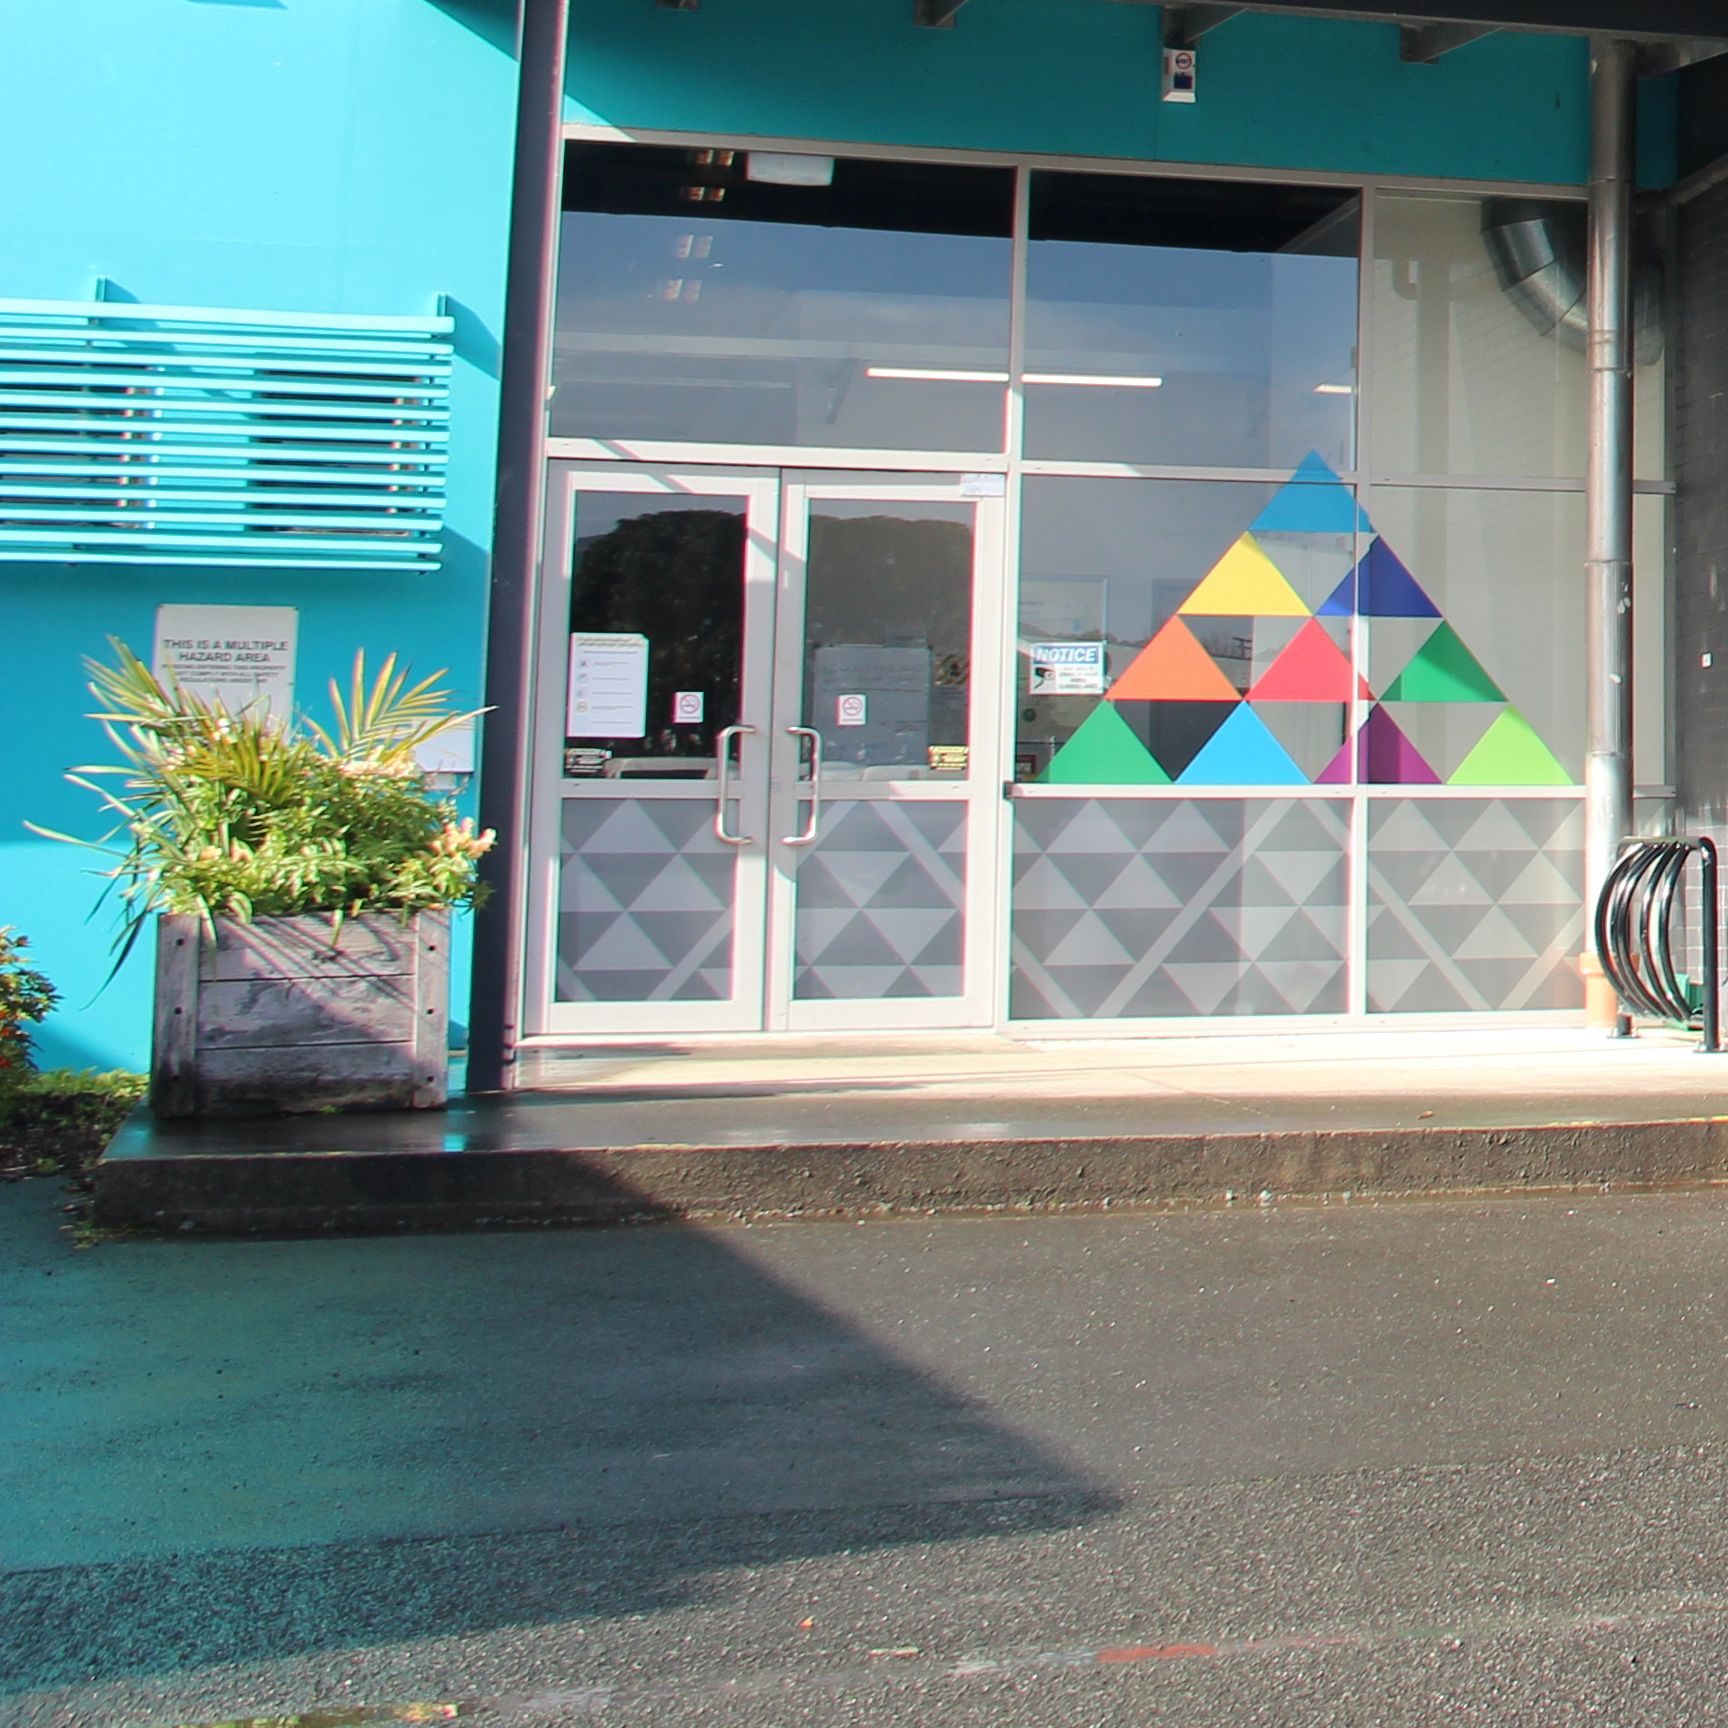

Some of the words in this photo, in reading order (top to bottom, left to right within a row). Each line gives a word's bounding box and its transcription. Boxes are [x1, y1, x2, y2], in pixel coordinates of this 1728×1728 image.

[163, 639, 194, 649] THIS
[197, 639, 210, 649] IS
[213, 640, 223, 650] A
[225, 639, 289, 651] MULTIPLE
[179, 651, 233, 662] HAZARD
[235, 652, 272, 663] AREA
[1036, 647, 1097, 662] NOTICE
